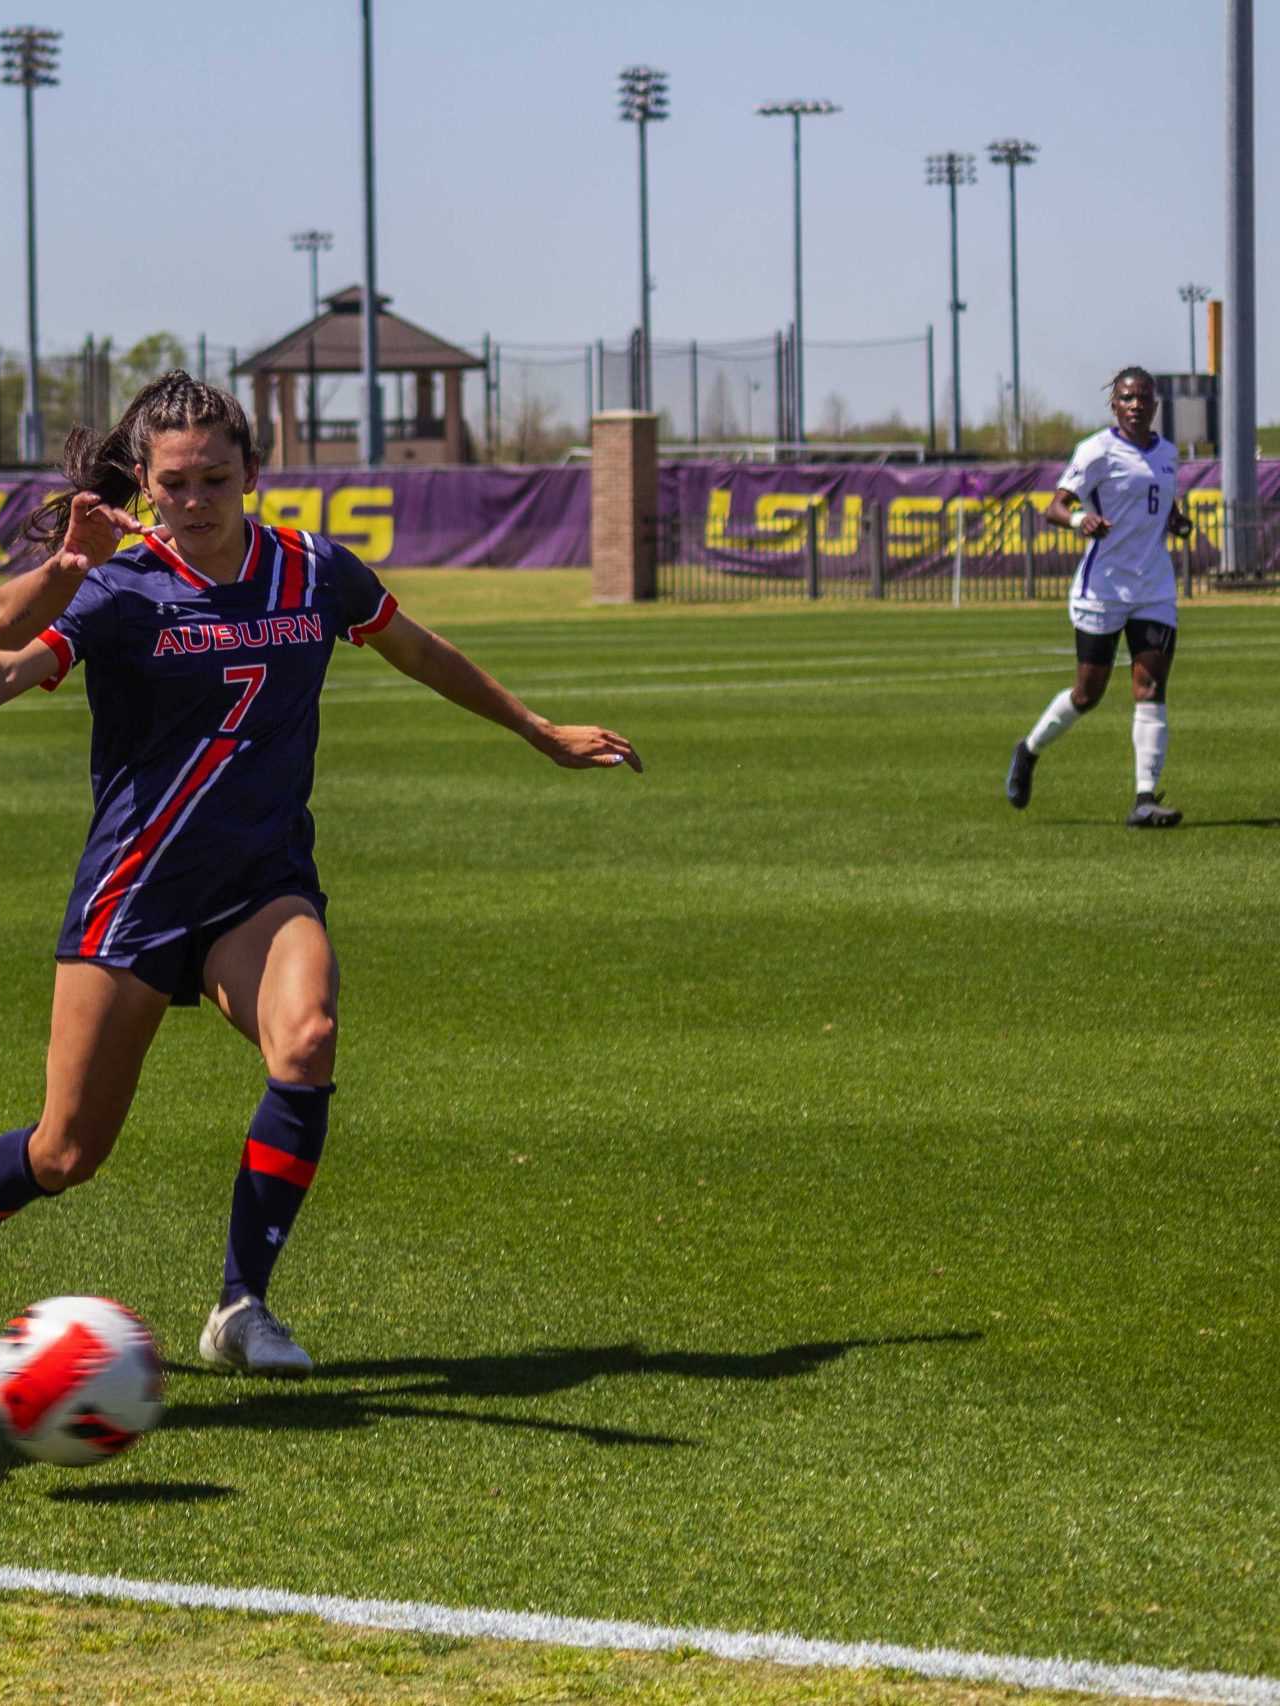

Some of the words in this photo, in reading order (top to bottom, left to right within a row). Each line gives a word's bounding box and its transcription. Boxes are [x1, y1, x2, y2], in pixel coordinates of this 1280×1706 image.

[705, 488, 862, 557] LSU
[1147, 484, 1160, 515] 6
[153, 613, 323, 657] AUBURN
[218, 663, 267, 732] 7
